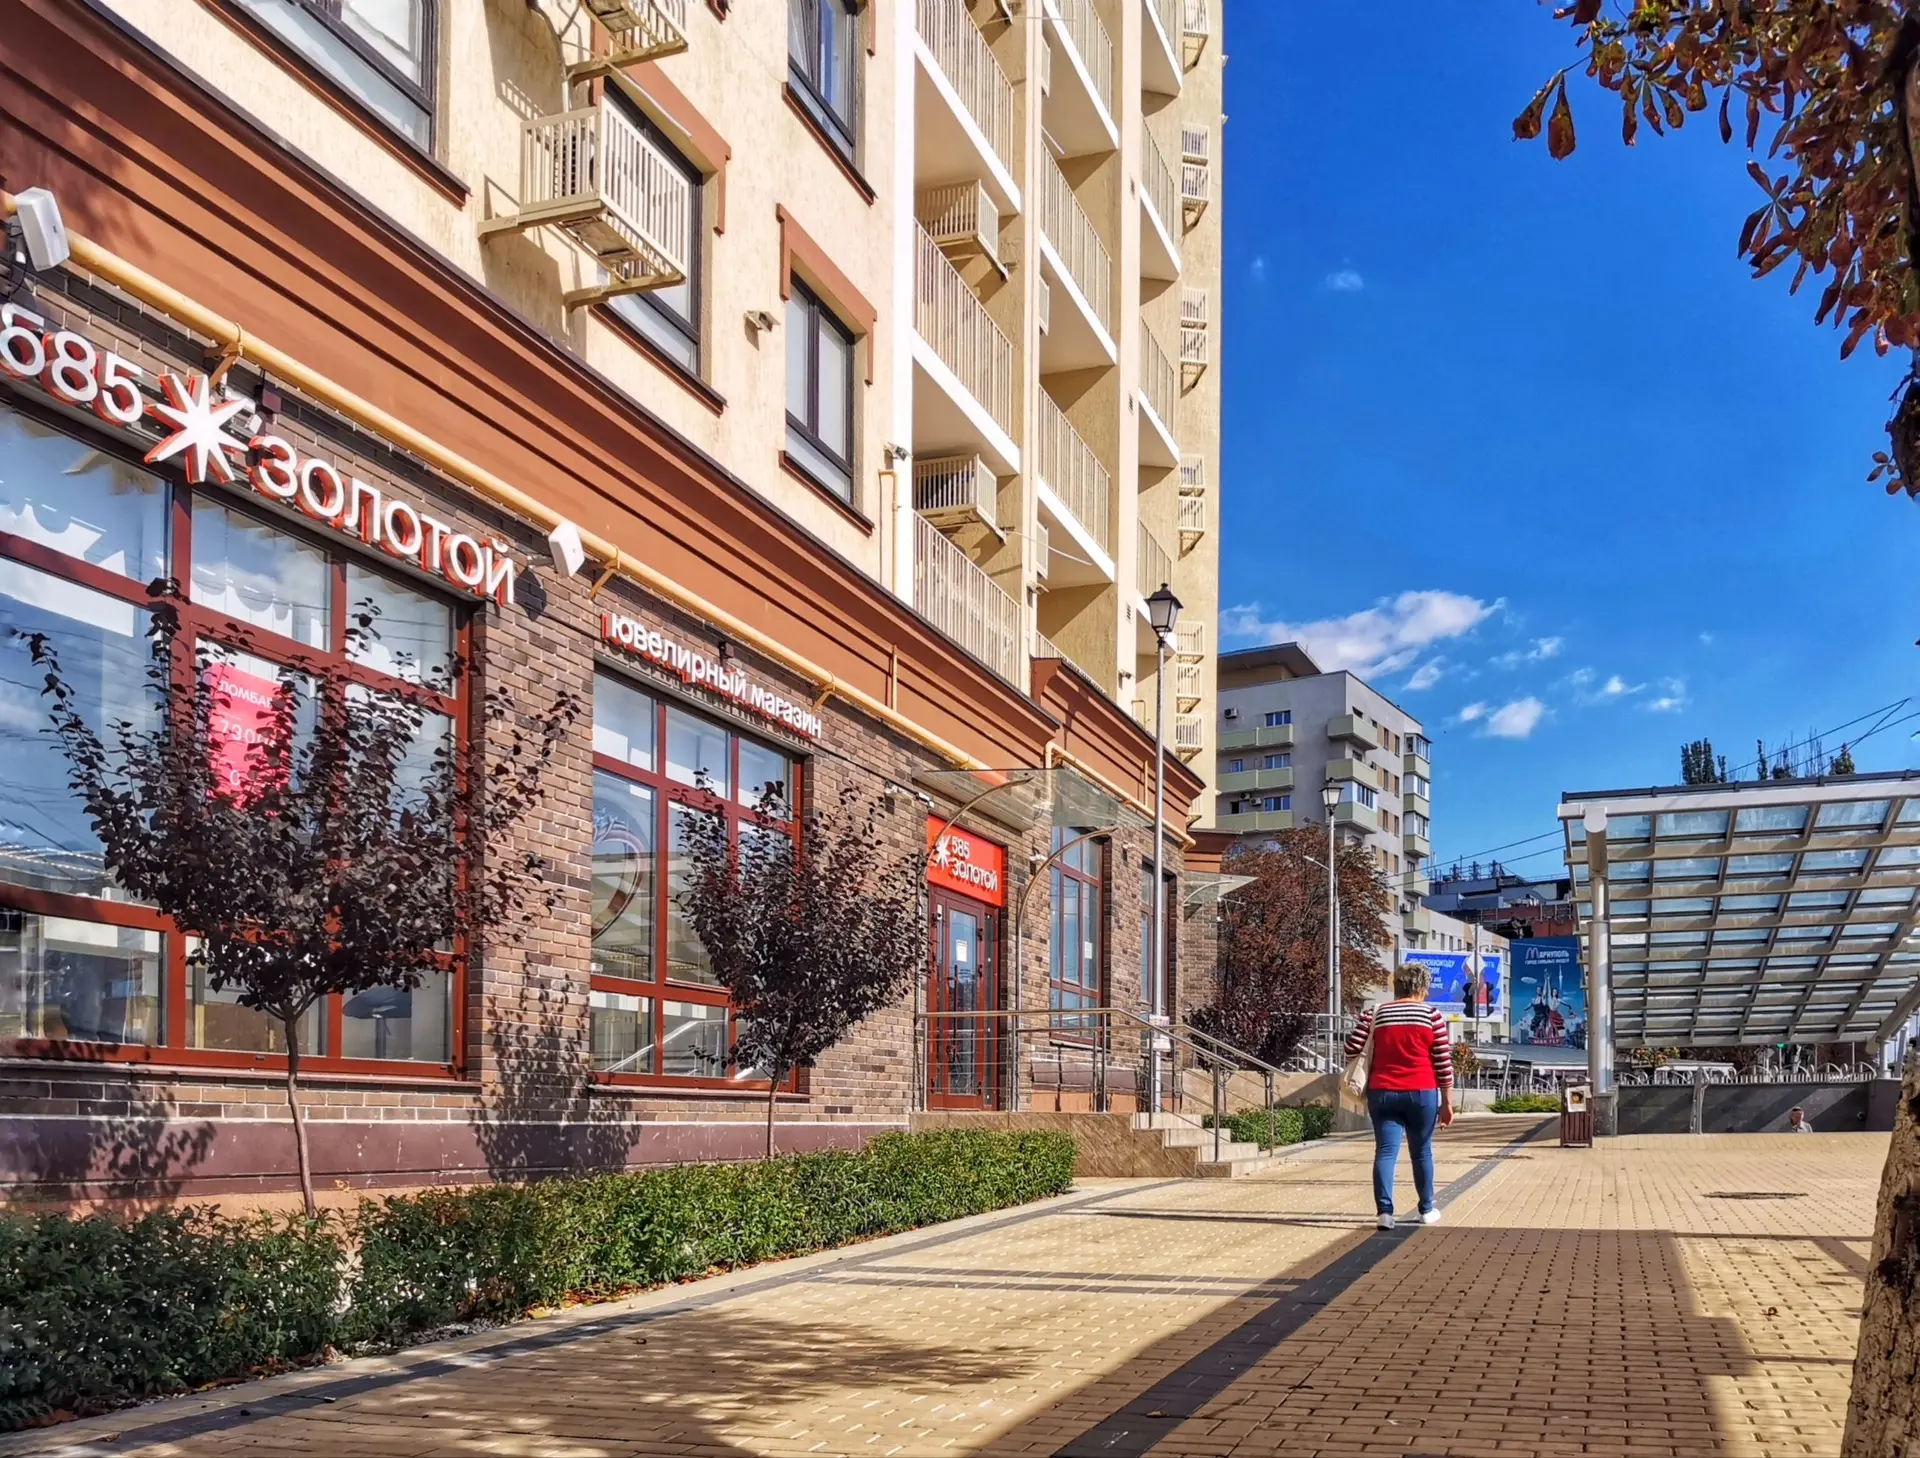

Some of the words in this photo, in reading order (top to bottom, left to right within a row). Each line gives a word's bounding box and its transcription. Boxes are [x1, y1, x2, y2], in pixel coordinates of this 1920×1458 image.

[219, 680, 274, 709] ЛОМБАР
[750, 684, 822, 740] магазин
[951, 835, 970, 860] 585
